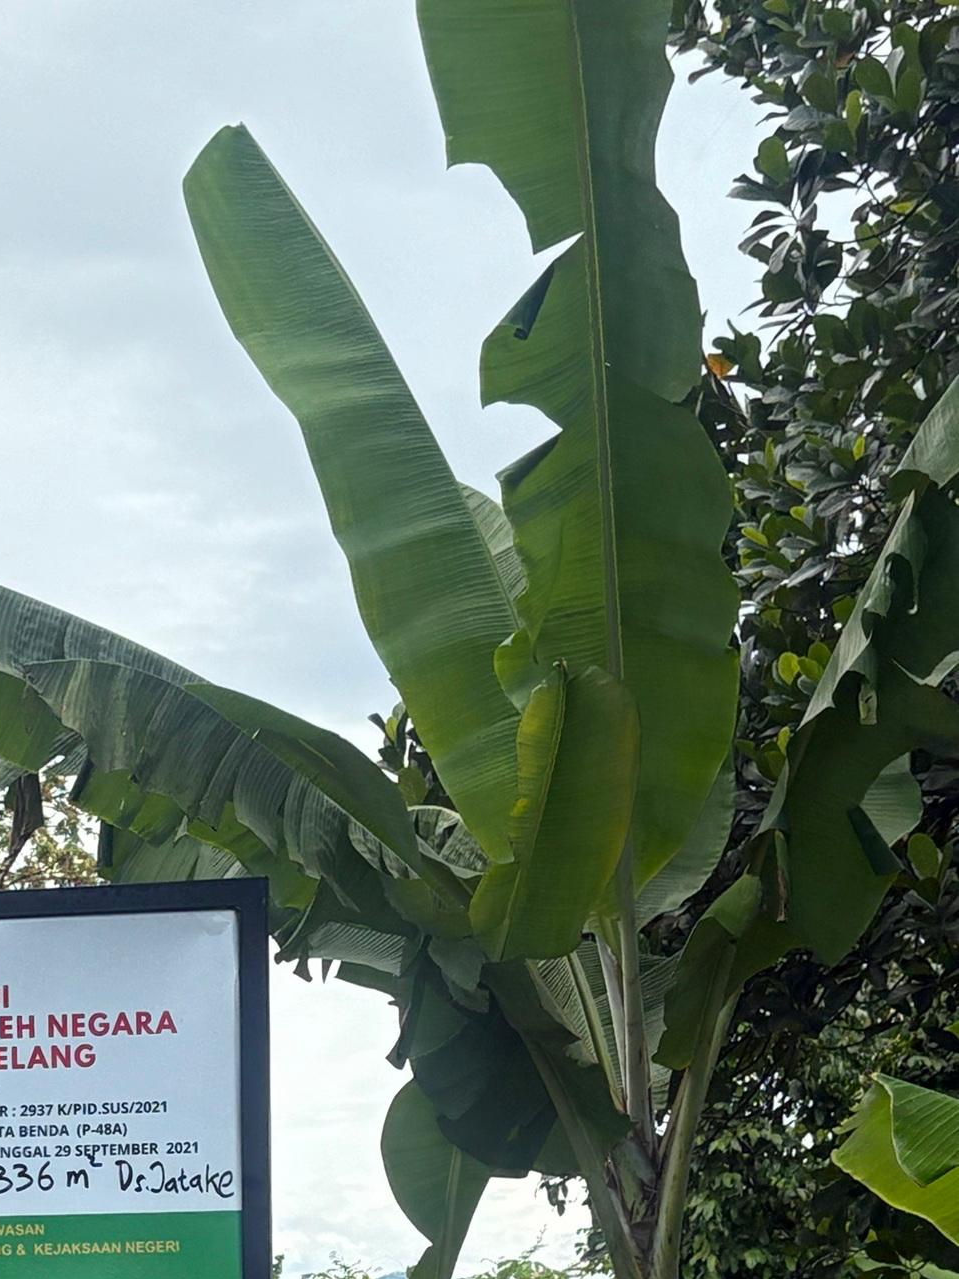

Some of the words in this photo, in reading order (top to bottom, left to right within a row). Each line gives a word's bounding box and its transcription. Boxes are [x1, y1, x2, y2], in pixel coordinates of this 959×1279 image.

[47, 1010, 178, 1037] NEGARA
[20, 1104, 53, 1117] 2937
[57, 1100, 168, 1116] K/PID.SUS/2021
[19, 1124, 69, 1137] BENDA
[76, 1122, 128, 1138] (P-48A)
[54, 1145, 71, 1157] 29
[75, 1142, 159, 1157] SEPTEMBER
[166, 1141, 199, 1154] 2021
[16, 1242, 26, 1256] &
[34, 1240, 121, 1255] KEJAKSAAN
[125, 1240, 180, 1253] NEGERI
